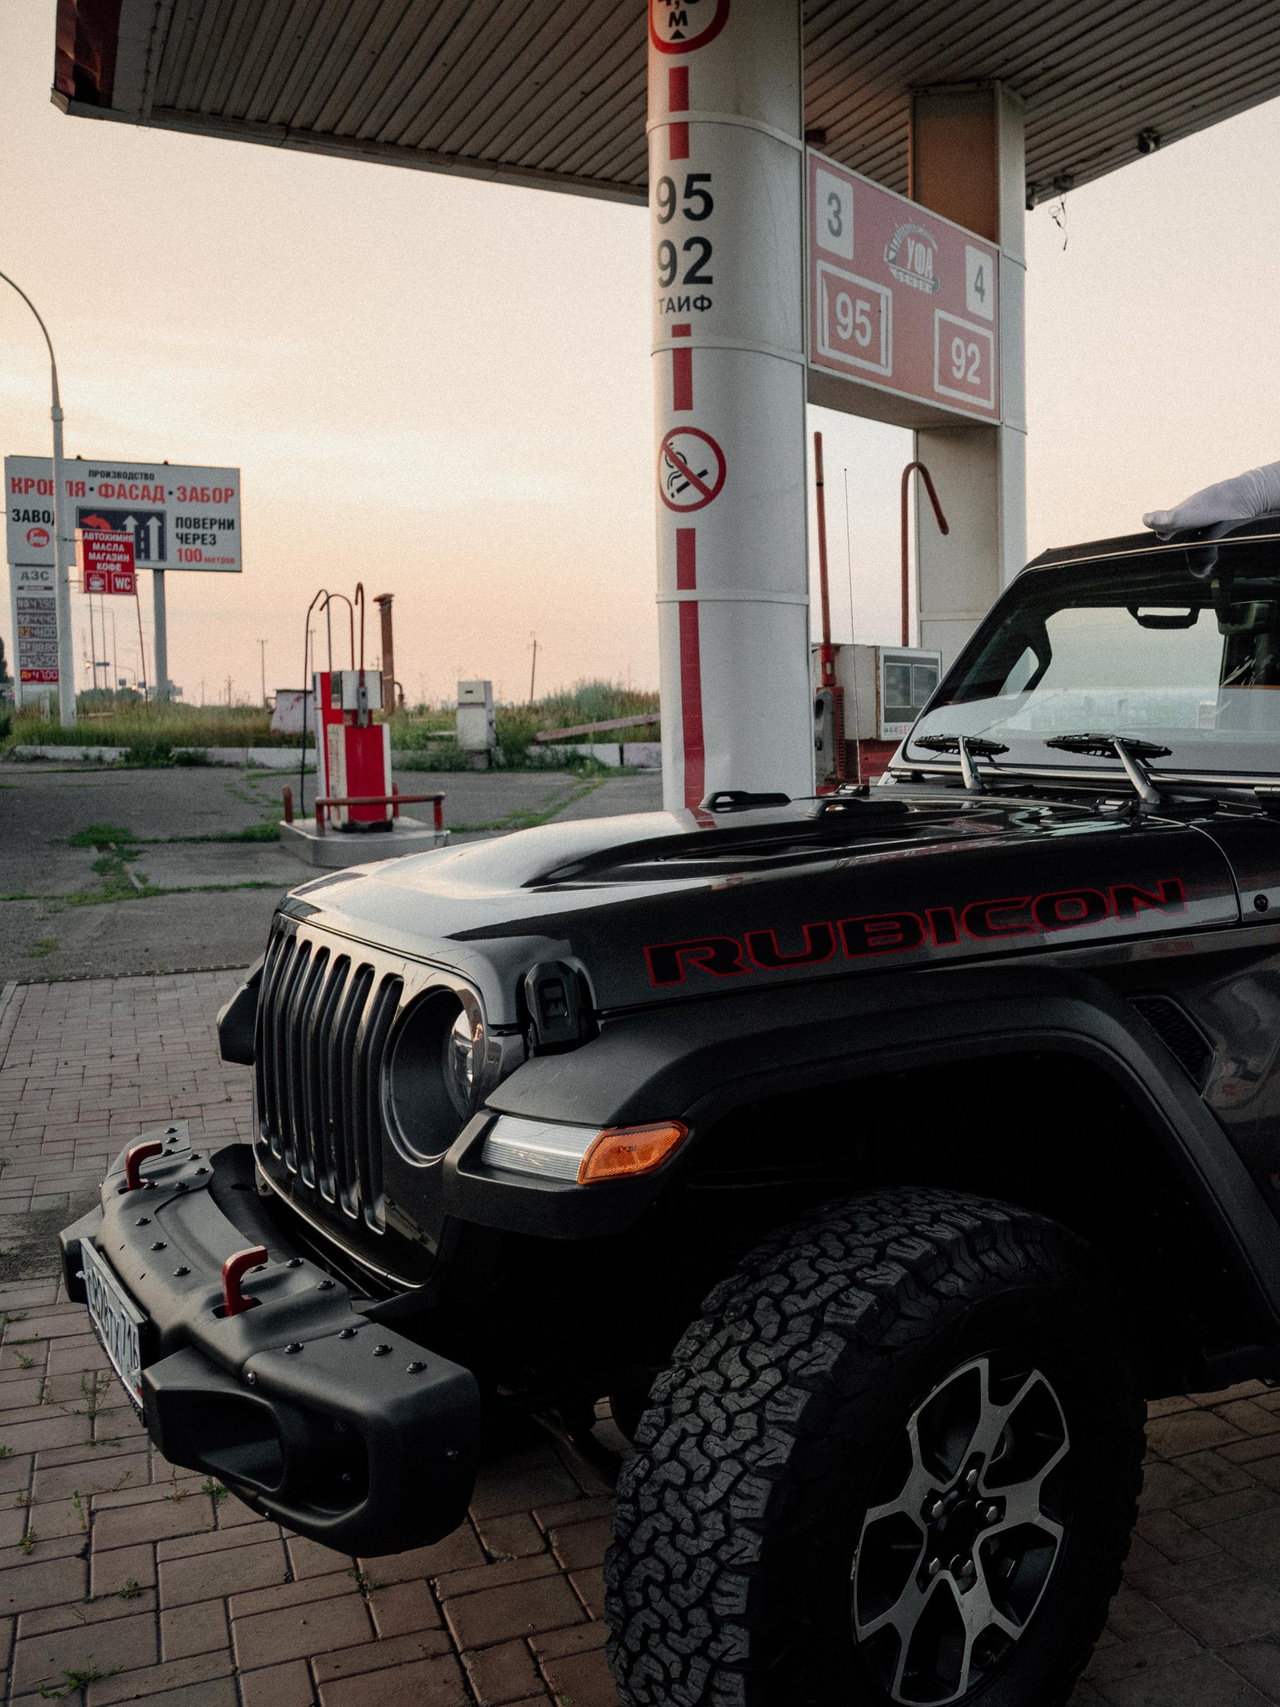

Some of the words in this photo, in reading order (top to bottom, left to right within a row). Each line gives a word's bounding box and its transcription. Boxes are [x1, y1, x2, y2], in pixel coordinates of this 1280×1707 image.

[656, 173, 714, 225] 95
[826, 192, 843, 237] 3
[657, 236, 714, 288] 92
[974, 265, 986, 303] 4
[658, 295, 713, 315] ТАИФ
[835, 292, 872, 347] 95
[951, 336, 981, 385] 92
[88, 469, 155, 481] ПРОИЗВОДСТВО
[97, 482, 165, 504] ФАСАД
[176, 486, 235, 504] ЗАБОР
[12, 508, 54, 526] ЗАВО
[175, 516, 235, 531] ПОВЕРНИ
[83, 532, 134, 543] АВТОХИМИЯ
[175, 533, 217, 546] ЧЕРЕЗ
[92, 542, 125, 552] МАСЛА
[177, 547, 203, 563] 100
[88, 552, 130, 563] МАГАЗИН
[21, 570, 50, 581] АЗС
[96, 562, 122, 572] КОФЕ
[115, 577, 131, 590] WC
[643, 878, 1189, 987] RUBICON
